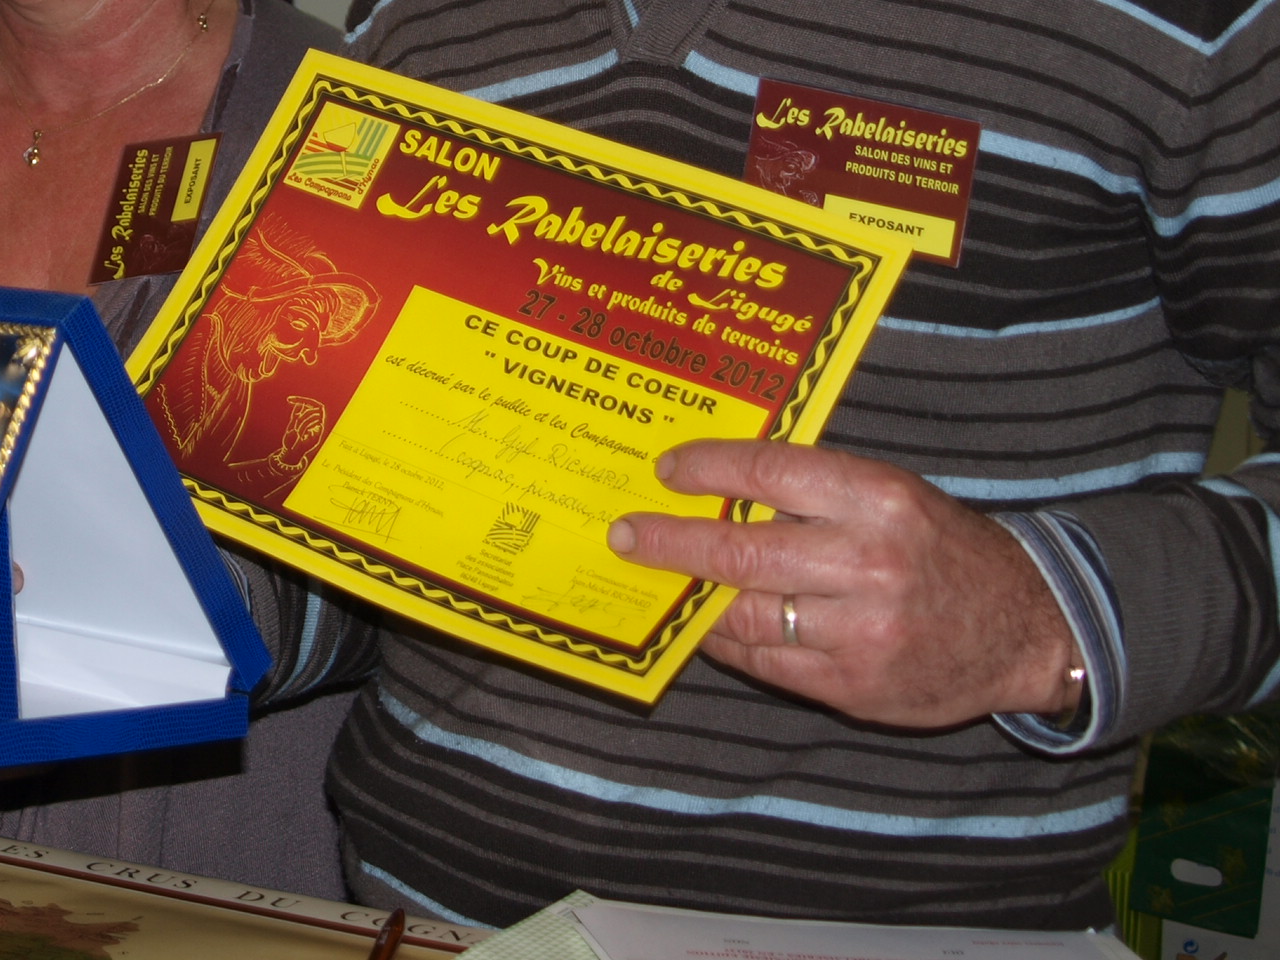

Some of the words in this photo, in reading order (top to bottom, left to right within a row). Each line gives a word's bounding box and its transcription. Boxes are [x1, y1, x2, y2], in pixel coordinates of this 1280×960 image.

[399, 129, 501, 181] SALON
[756, 98, 811, 129] Les
[815, 107, 968, 158] Rabelaiseries
[184, 158, 203, 204] EXPOSANT
[287, 172, 303, 184] Les
[304, 177, 353, 202] Compagnons
[845, 161, 896, 181] PRODUITS
[898, 172, 913, 184] DU
[915, 175, 959, 195] TERROIR
[854, 145, 889, 161] SALON
[890, 153, 911, 166] DES
[913, 158, 937, 171] VINS
[939, 163, 953, 175] ET
[112, 149, 149, 240] Rabelaiseries
[849, 212, 925, 237] EXPOSANT
[376, 175, 482, 220] Les
[487, 195, 788, 288] Rabelaiseries
[104, 246, 126, 279] Les
[650, 270, 684, 291] de
[532, 258, 584, 292] Vins
[587, 280, 607, 300] et
[607, 288, 688, 327] produits
[692, 314, 716, 336] de
[721, 326, 800, 367] terroirs
[464, 314, 500, 338] CE
[505, 327, 578, 364] COUP
[583, 356, 621, 381] DE
[626, 371, 718, 415] COEUR
[518, 289, 557, 321] 27
[570, 306, 608, 339] 28
[609, 325, 708, 377] octobre
[710, 354, 787, 403] 2012
[385, 353, 405, 367] est
[406, 361, 454, 386] décerné
[449, 380, 475, 396] par
[477, 387, 491, 402] le
[491, 394, 531, 419] public
[534, 410, 548, 423] et
[549, 415, 568, 431] les
[570, 422, 649, 461] Compagnons
[502, 357, 654, 425] VIGNERONS
[85, 861, 199, 890] CRUS
[235, 889, 303, 910] DU
[340, 910, 475, 944] COGN
